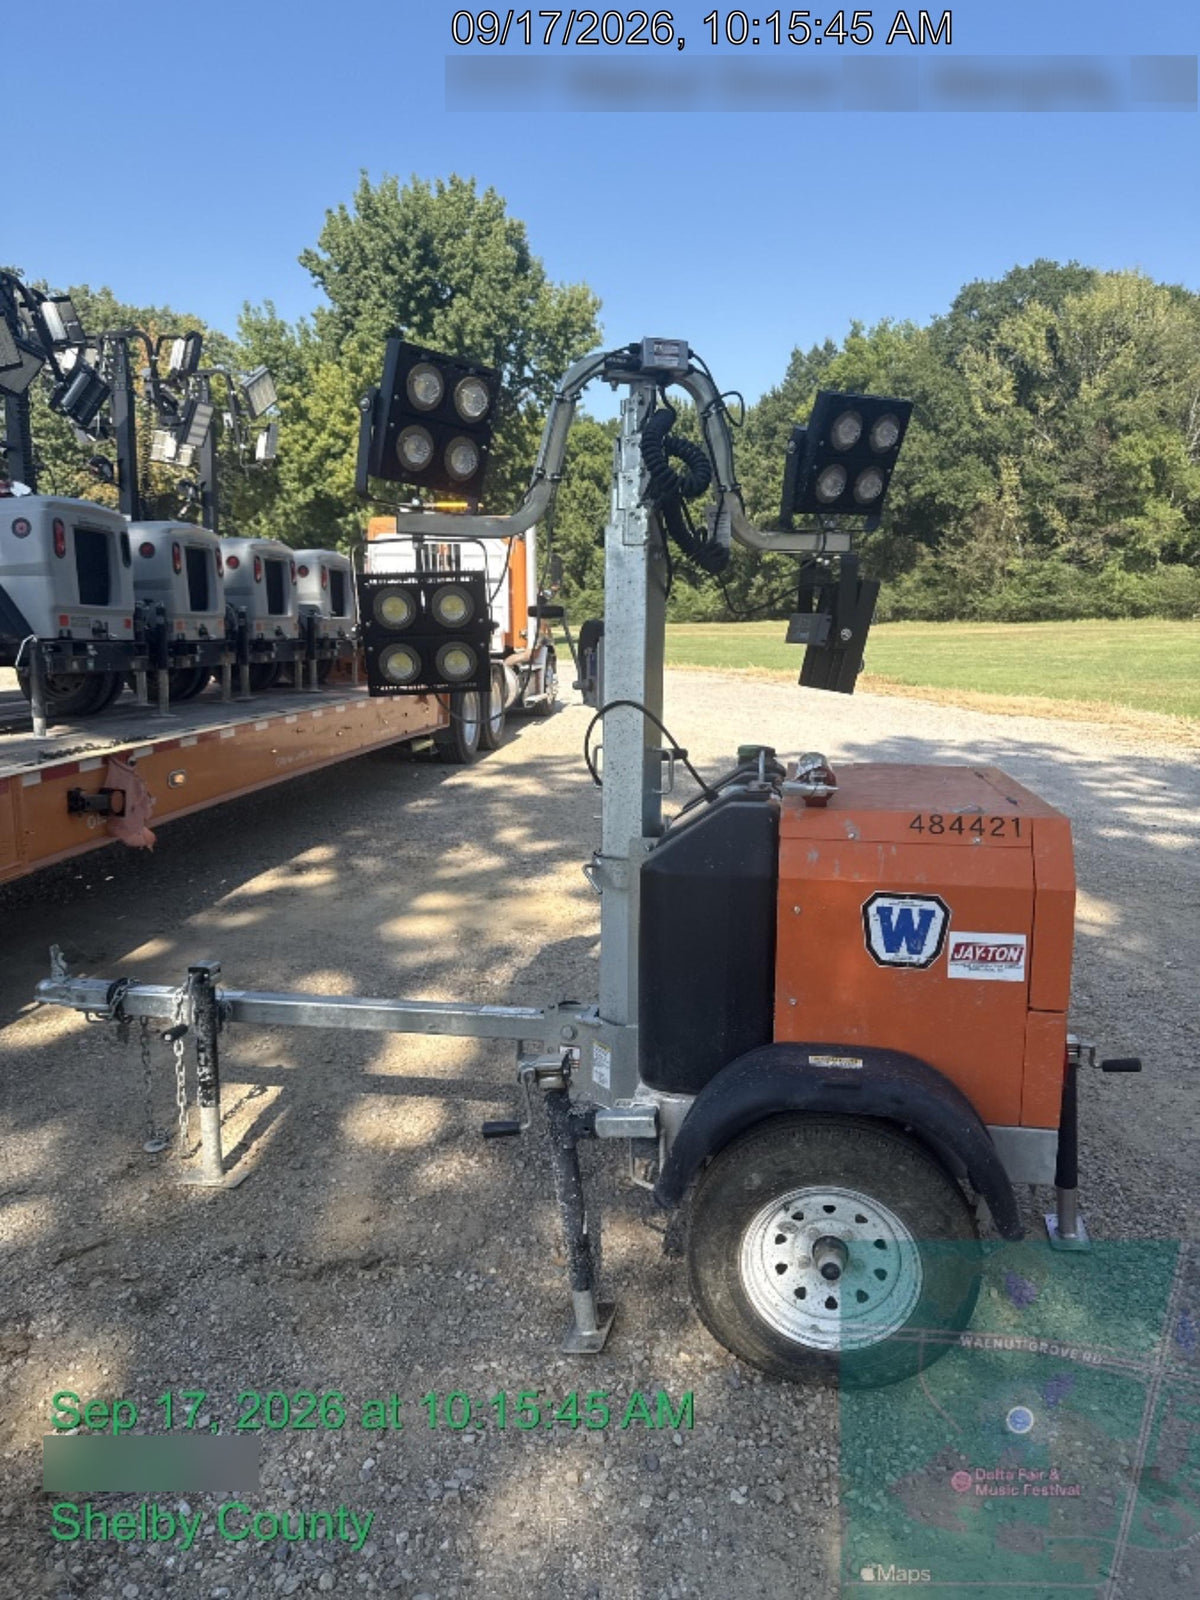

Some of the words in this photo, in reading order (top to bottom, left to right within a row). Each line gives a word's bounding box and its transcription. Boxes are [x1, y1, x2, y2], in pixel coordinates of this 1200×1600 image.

[909, 814, 1022, 838] 484421
[876, 906, 936, 955] W
[954, 945, 1021, 962] JAY-TON
